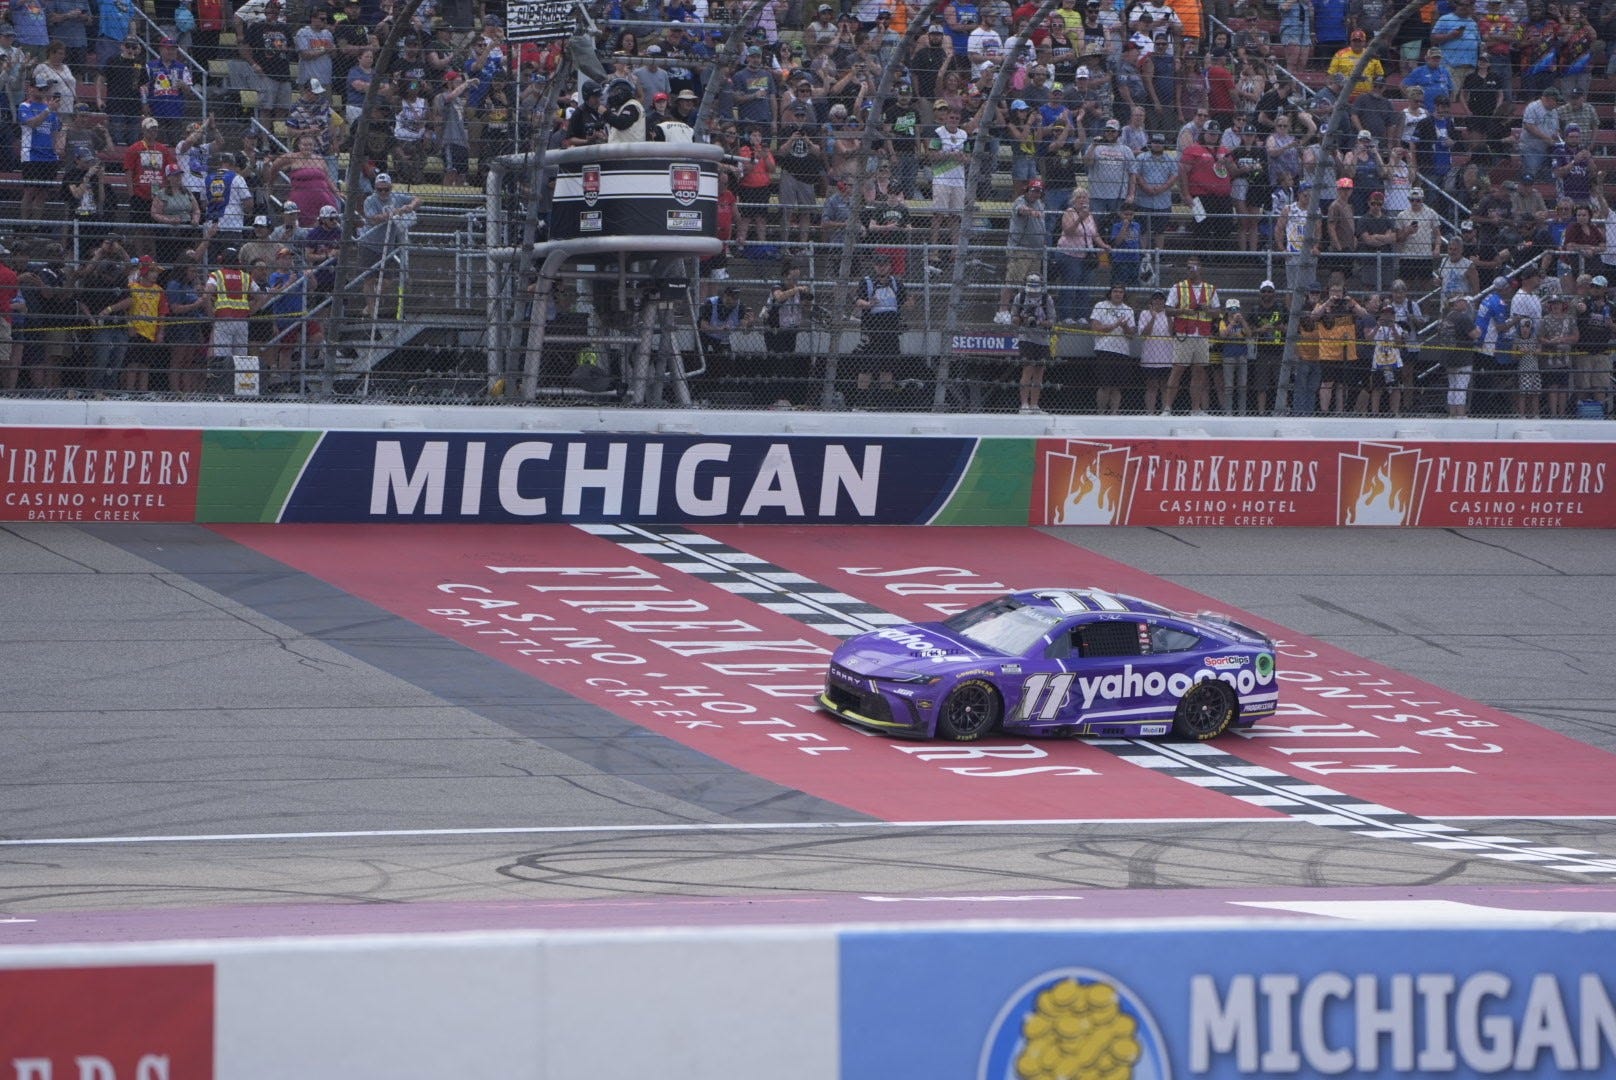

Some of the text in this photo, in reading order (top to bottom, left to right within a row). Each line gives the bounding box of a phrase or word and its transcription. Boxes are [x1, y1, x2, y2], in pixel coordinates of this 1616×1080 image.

[952, 335, 1020, 350] SECTION 2
[369, 440, 883, 517] MICHIGAN
[1144, 455, 1319, 492] FIREKEEPERS
[1435, 457, 1607, 494] FIREKEEPERS
[6, 493, 165, 506] CASINO HOTEL
[1160, 500, 1296, 513] CASINO HOTEL
[1450, 501, 1584, 514] CASINO HOTEL
[28, 510, 140, 520] BATTLE CREEK
[1179, 515, 1274, 525] BATTLE CREEK
[1468, 516, 1562, 527] BATTLE CREEK
[1032, 590, 1130, 613] 11
[427, 608, 724, 730] BATTLE CREEK
[437, 583, 850, 756] CASINO HOTEL
[831, 668, 861, 685] CAMRY
[1018, 673, 1077, 720] 11
